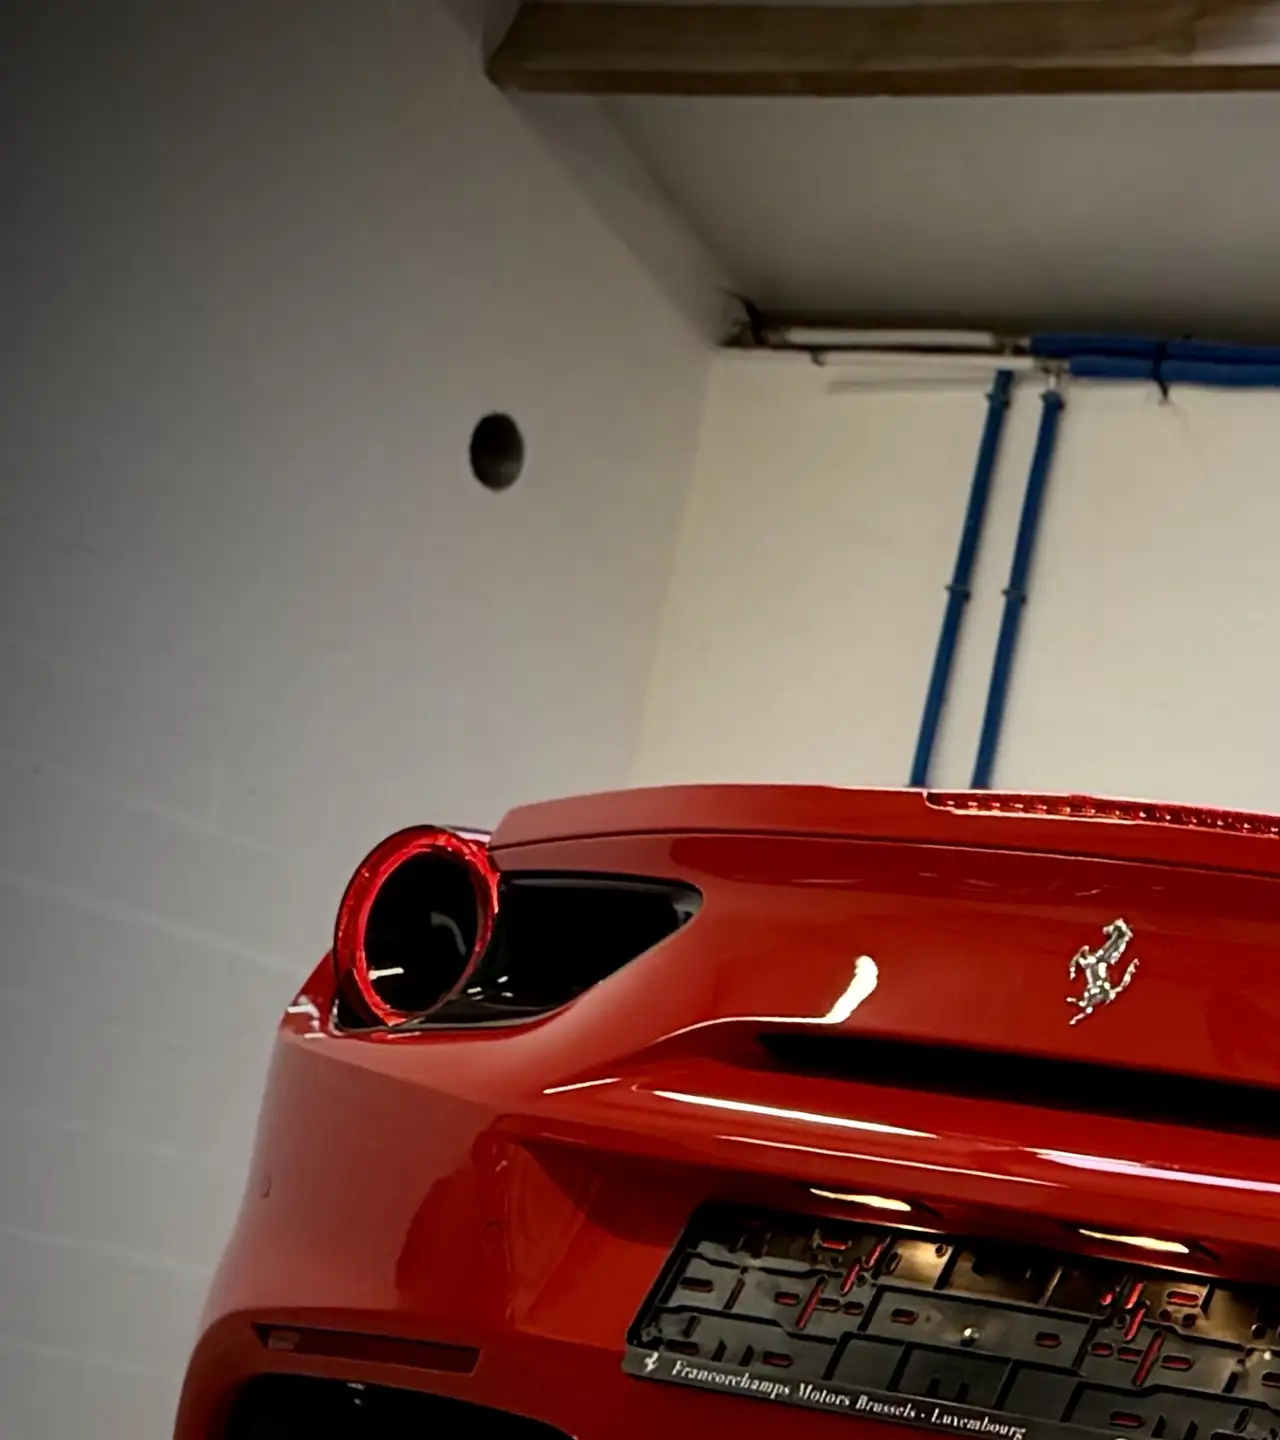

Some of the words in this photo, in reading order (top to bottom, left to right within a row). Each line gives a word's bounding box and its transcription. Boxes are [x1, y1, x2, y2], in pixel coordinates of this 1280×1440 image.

[671, 1359, 791, 1399] Francorchamps
[799, 1382, 851, 1407] Motors
[855, 1394, 917, 1420] Brussels
